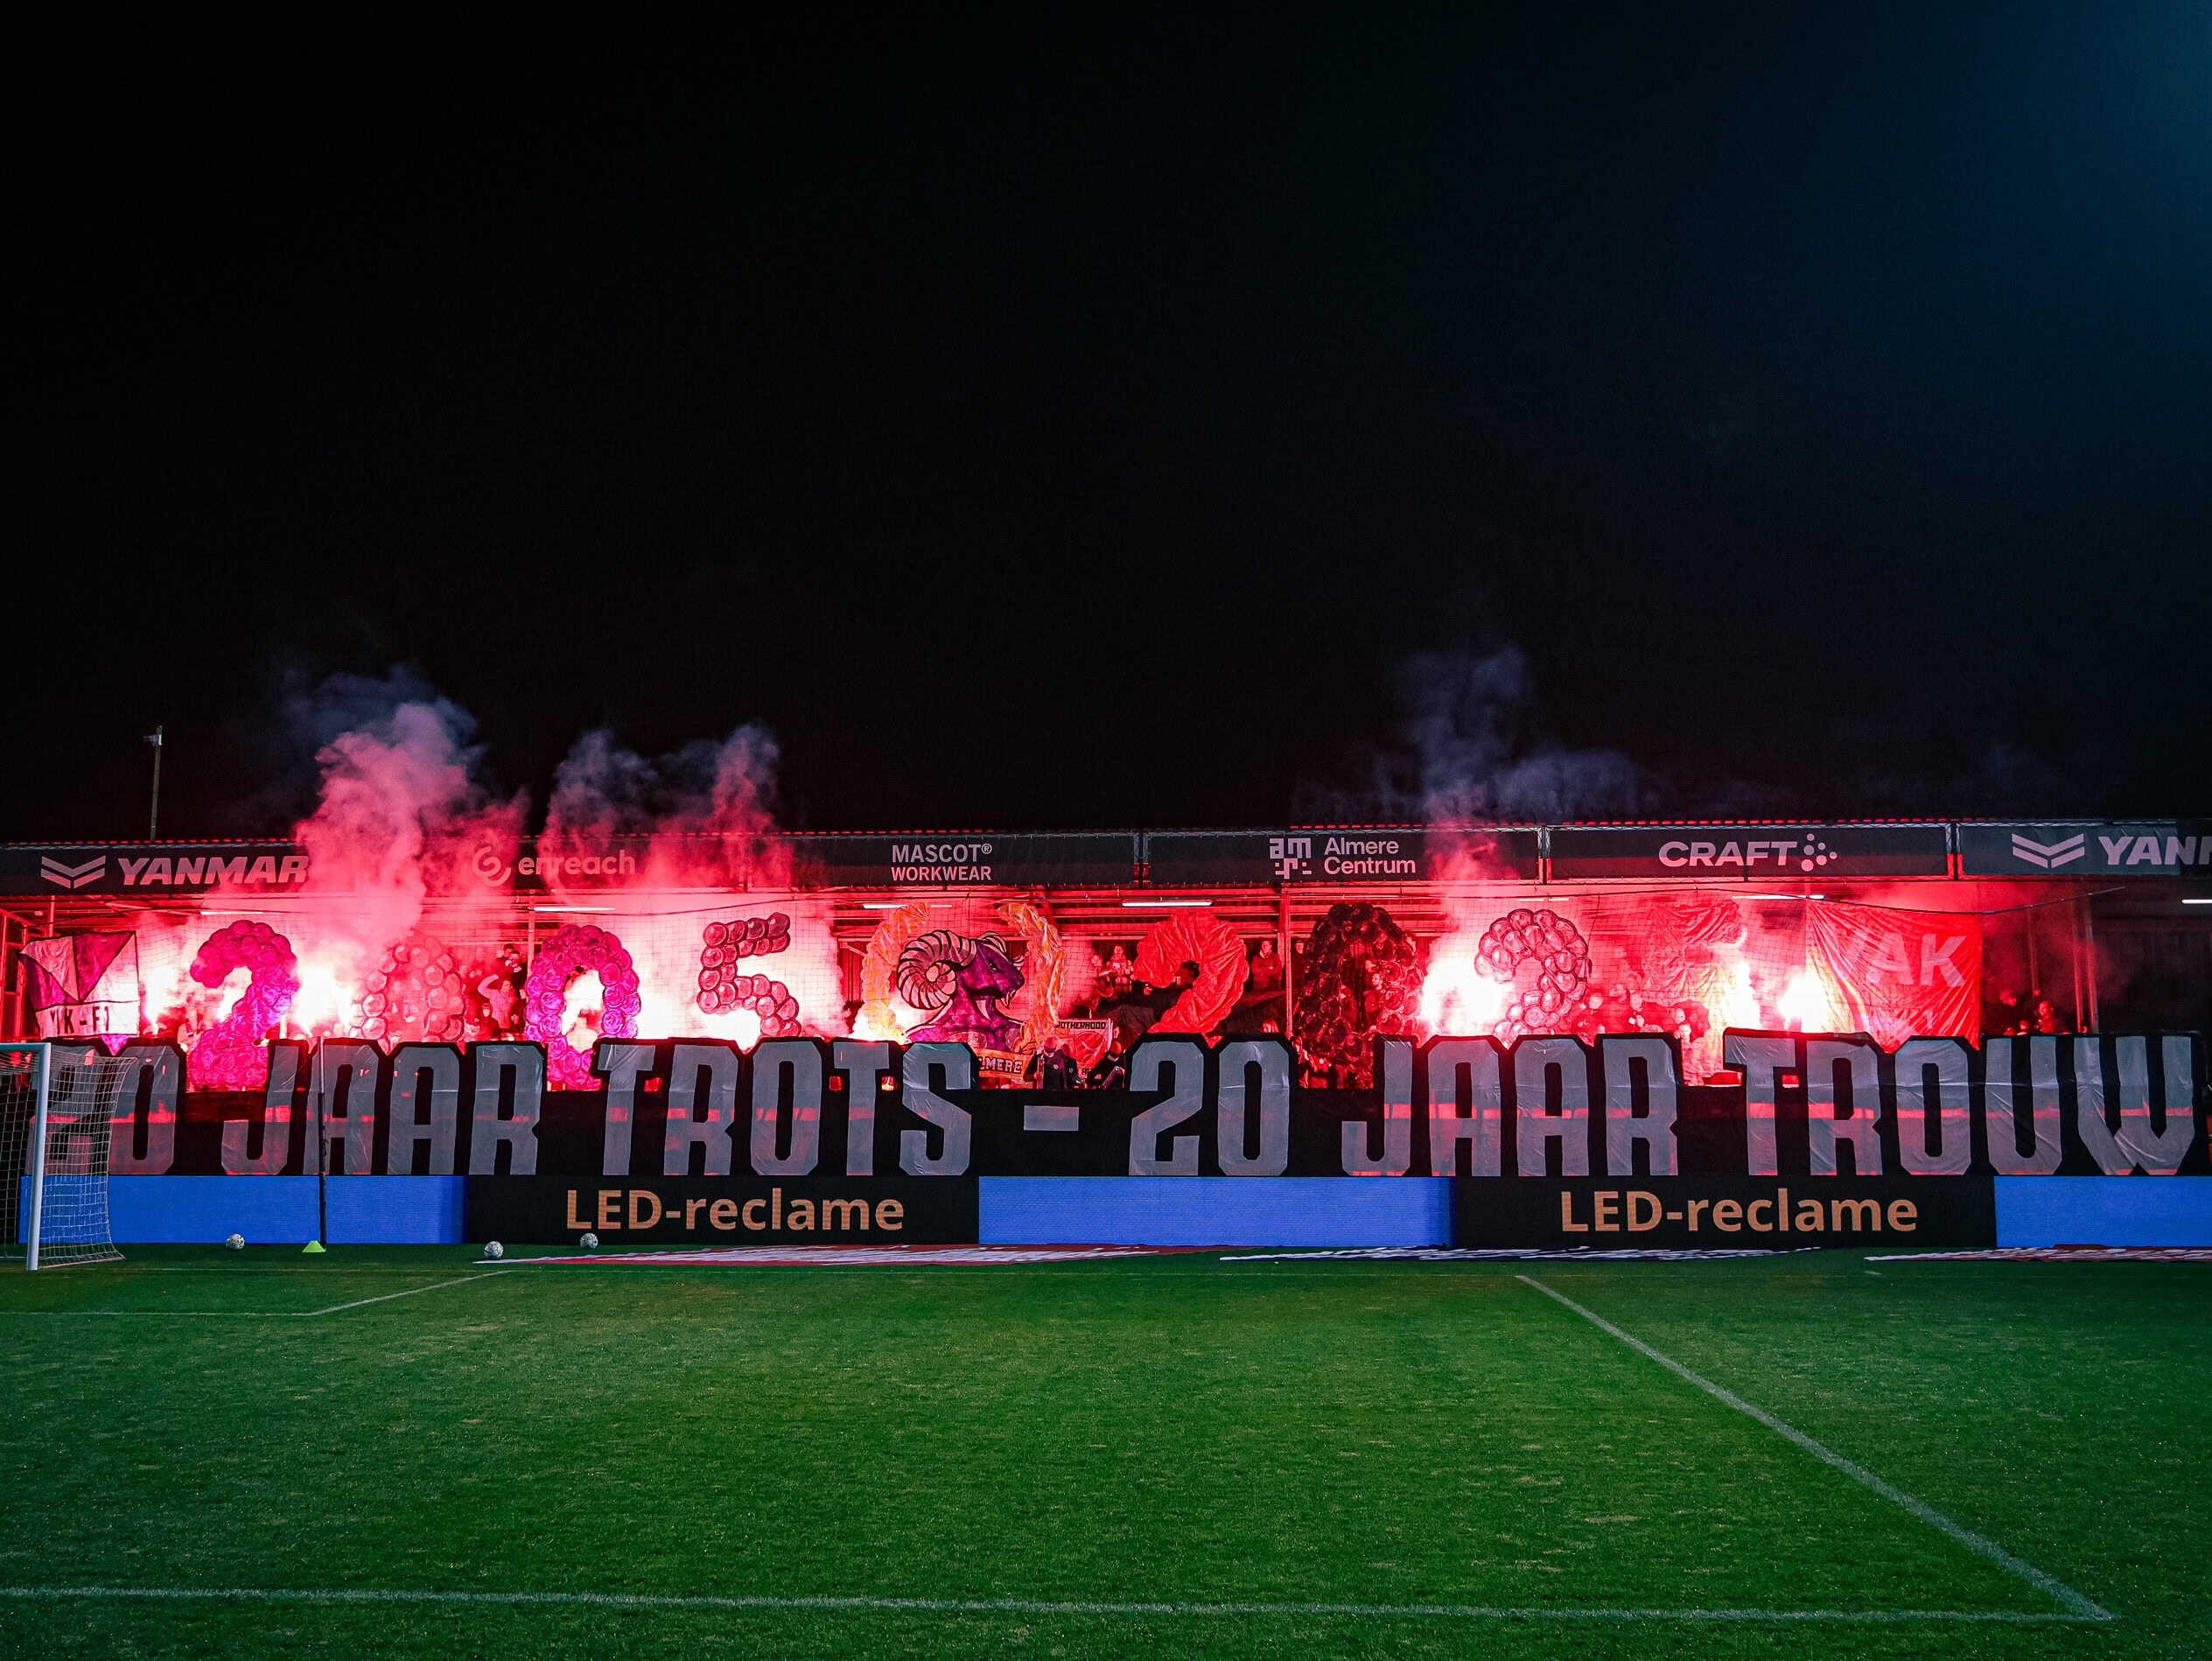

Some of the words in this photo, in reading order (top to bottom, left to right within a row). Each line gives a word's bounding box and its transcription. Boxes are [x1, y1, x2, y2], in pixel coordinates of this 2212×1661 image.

[1324, 838, 1399, 855] Almere
[1659, 841, 1798, 867] CRAFT
[118, 856, 309, 885] YANMAR
[518, 849, 636, 875] enreach
[891, 866, 992, 881] WORKWEAR
[1324, 857, 1416, 875] Centrum
[220, 1045, 544, 1175] JAAR
[598, 1043, 971, 1176] TROTS
[1024, 1106, 1079, 1131] -
[1129, 1041, 1289, 1176] 20
[1341, 1039, 1677, 1176] JAAR
[1726, 1035, 2194, 1175] TROUW
[565, 1188, 905, 1230] LED-reclame
[1561, 1188, 1918, 1232] LED-reclame
